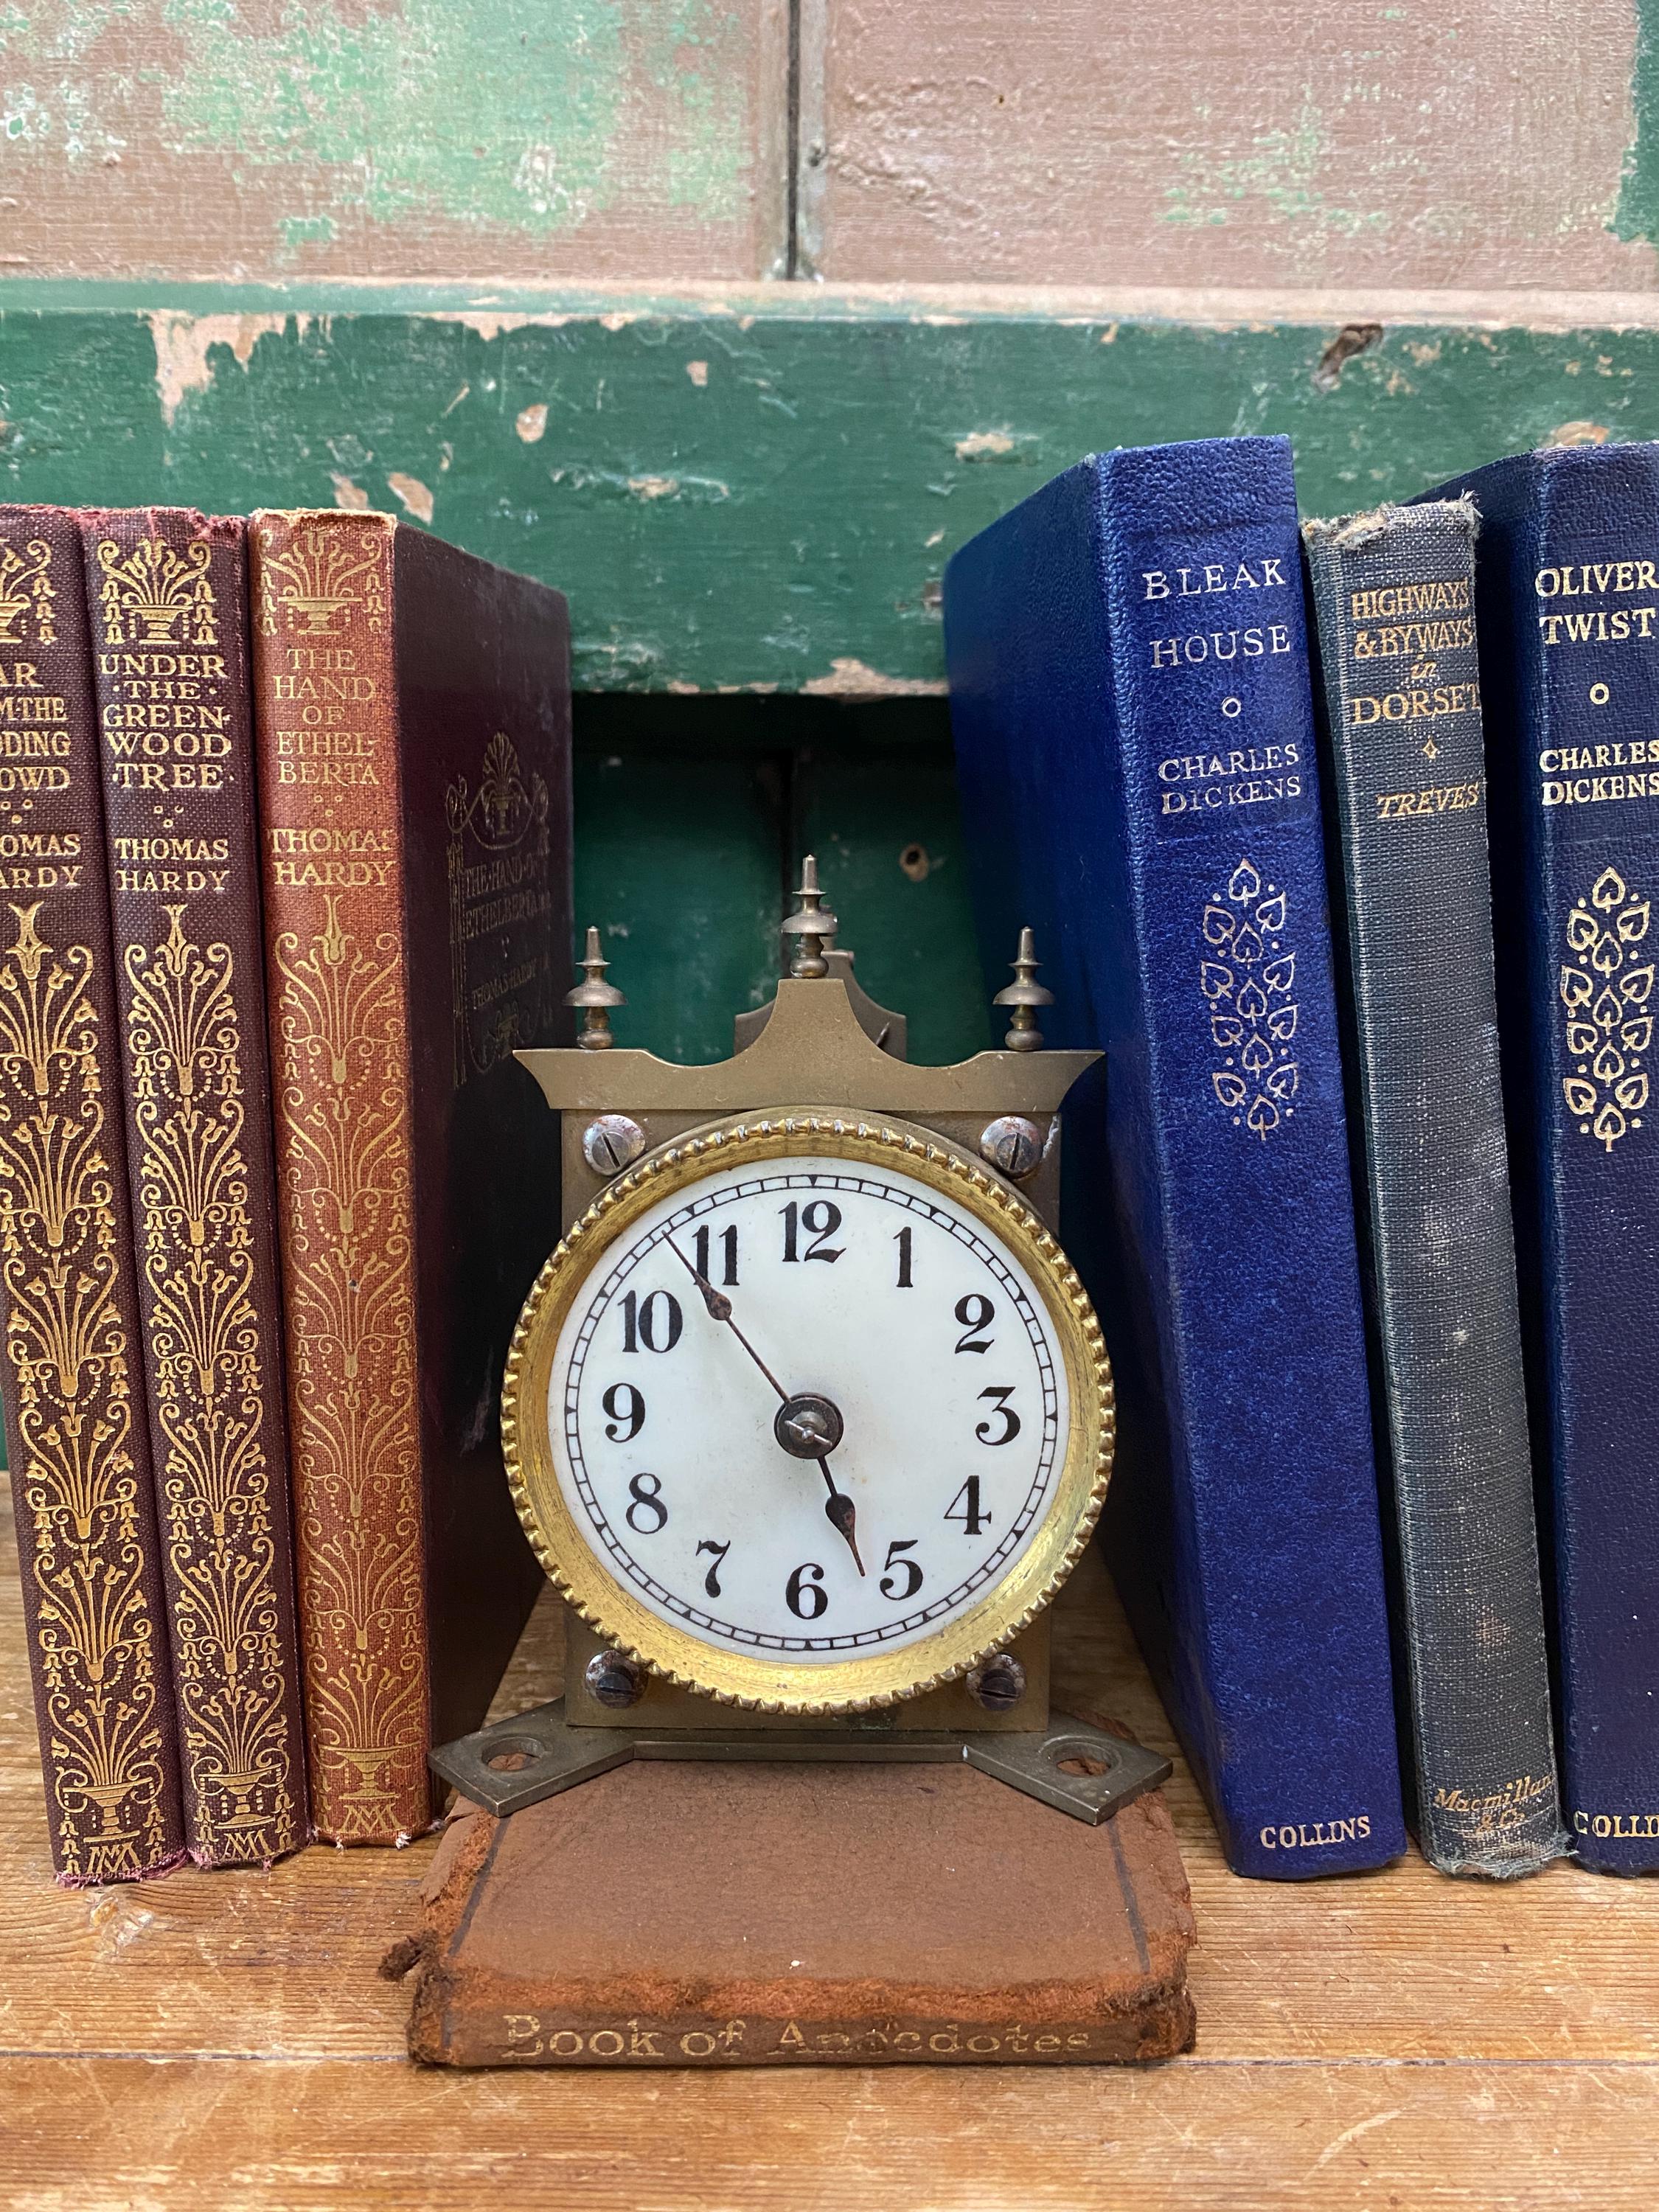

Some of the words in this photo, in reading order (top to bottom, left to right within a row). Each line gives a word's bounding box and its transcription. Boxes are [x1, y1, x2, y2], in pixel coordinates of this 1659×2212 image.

[1142, 558, 1286, 601] BLEAK
[1535, 560, 1659, 597] OLIVER
[1351, 577, 1470, 620] HIGHWAYS
[1354, 630, 1377, 659] &
[1377, 616, 1474, 657] BYWAYS
[1539, 607, 1656, 644] TWIST
[285, 648, 356, 670] THE
[1150, 625, 1290, 669] HOUSE
[98, 654, 229, 678] UNDER
[1410, 654, 1437, 680] in
[123, 681, 201, 699] THE
[274, 675, 376, 701] HAND
[103, 704, 233, 728] GREEN-
[302, 706, 345, 726] OF
[105, 731, 232, 757] WOOD
[276, 731, 380, 757] ETHEL-
[1158, 743, 1299, 782] CHARLES
[1539, 740, 1659, 773] CHARLES
[114, 762, 224, 791] TREE
[278, 762, 380, 786] BERTA
[1542, 773, 1659, 807] DICKENS
[1161, 776, 1302, 814] DICKENS
[1376, 782, 1480, 819] TREVES
[114, 838, 229, 860] THOMAS
[116, 869, 230, 891] HARDY
[273, 860, 397, 887] HARDY
[777, 1200, 846, 1263] 12
[692, 1224, 739, 1287] 11
[893, 1225, 914, 1289] 1
[618, 1289, 684, 1354] 10
[953, 1293, 995, 1354] 2
[601, 1382, 647, 1443] 9
[974, 1385, 1022, 1447] 3
[625, 1472, 668, 1535] 8
[943, 1475, 992, 1536] 4
[695, 1539, 731, 1599] 7
[878, 1539, 924, 1601] 5
[785, 1562, 828, 1620] 6
[1433, 1775, 1554, 1812] Macmillan
[1259, 1815, 1371, 1849] COLLINS
[1573, 1811, 1659, 1837] COLLI
[501, 2014, 664, 2058] Book
[679, 2019, 748, 2056] of
